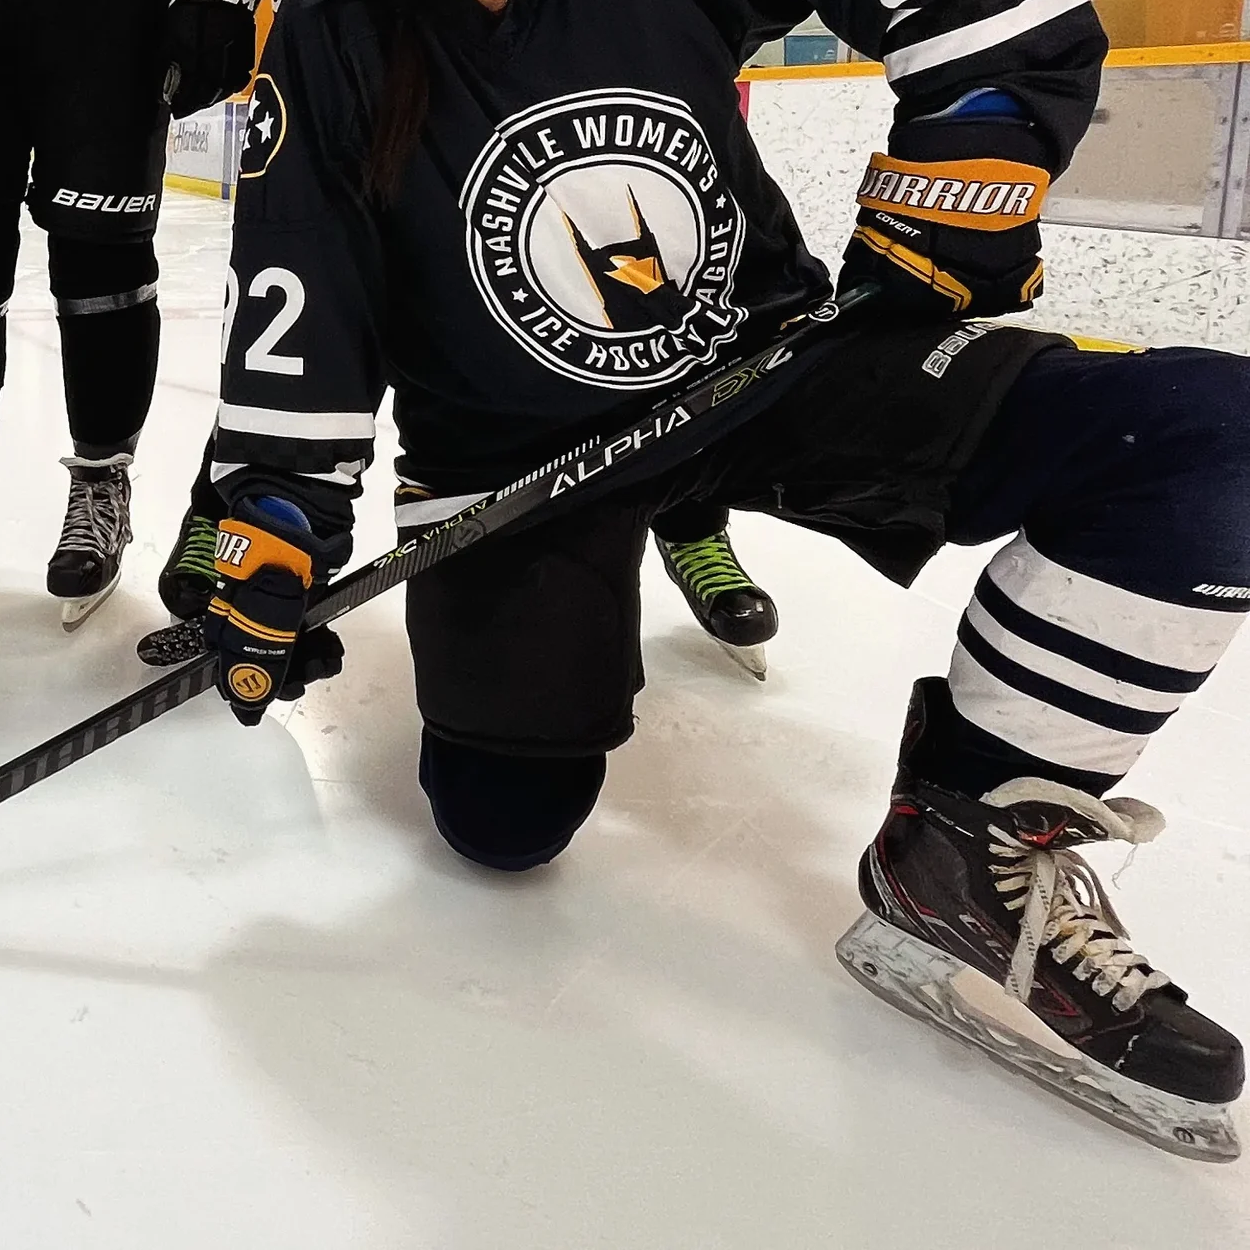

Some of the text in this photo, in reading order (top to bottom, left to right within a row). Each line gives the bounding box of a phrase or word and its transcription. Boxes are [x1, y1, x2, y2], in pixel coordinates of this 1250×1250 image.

[572, 114, 719, 193] WOMEN'S
[51, 188, 156, 213] BAUER
[875, 211, 922, 238] COVERT
[520, 306, 580, 352] ICE
[549, 405, 692, 499] ALPHA
[422, 500, 488, 541] ALPHA
